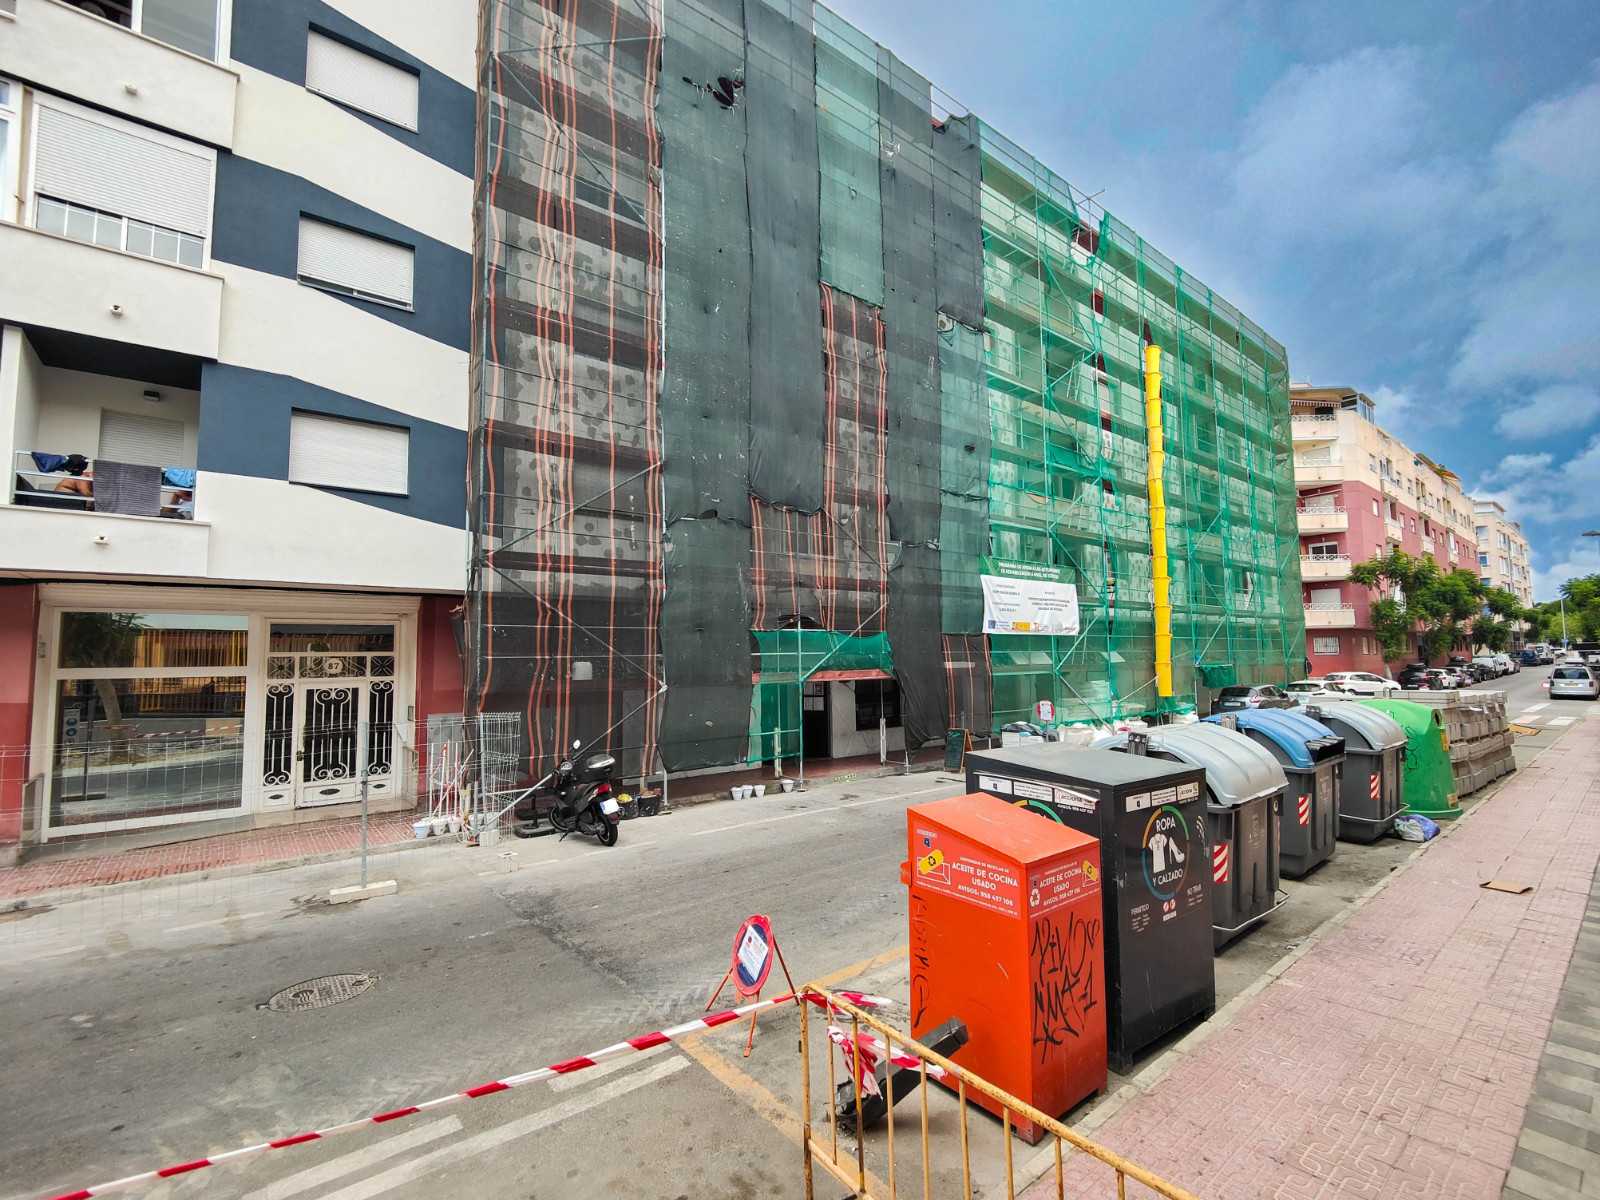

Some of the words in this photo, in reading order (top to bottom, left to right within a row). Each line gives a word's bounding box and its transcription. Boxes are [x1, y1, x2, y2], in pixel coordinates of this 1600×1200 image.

[1156, 816, 1176, 832] ROPA
[952, 862, 975, 874] ACEITE
[977, 868, 986, 878] DE
[988, 872, 1018, 887] COCINA
[1040, 876, 1055, 888] ACEITE
[1057, 874, 1063, 882] DE
[1064, 867, 1082, 878] COCINA
[1152, 878, 1156, 886] Y
[1157, 868, 1183, 885] CALZADO
[972, 878, 996, 890] USADO
[1053, 881, 1069, 893] USADO
